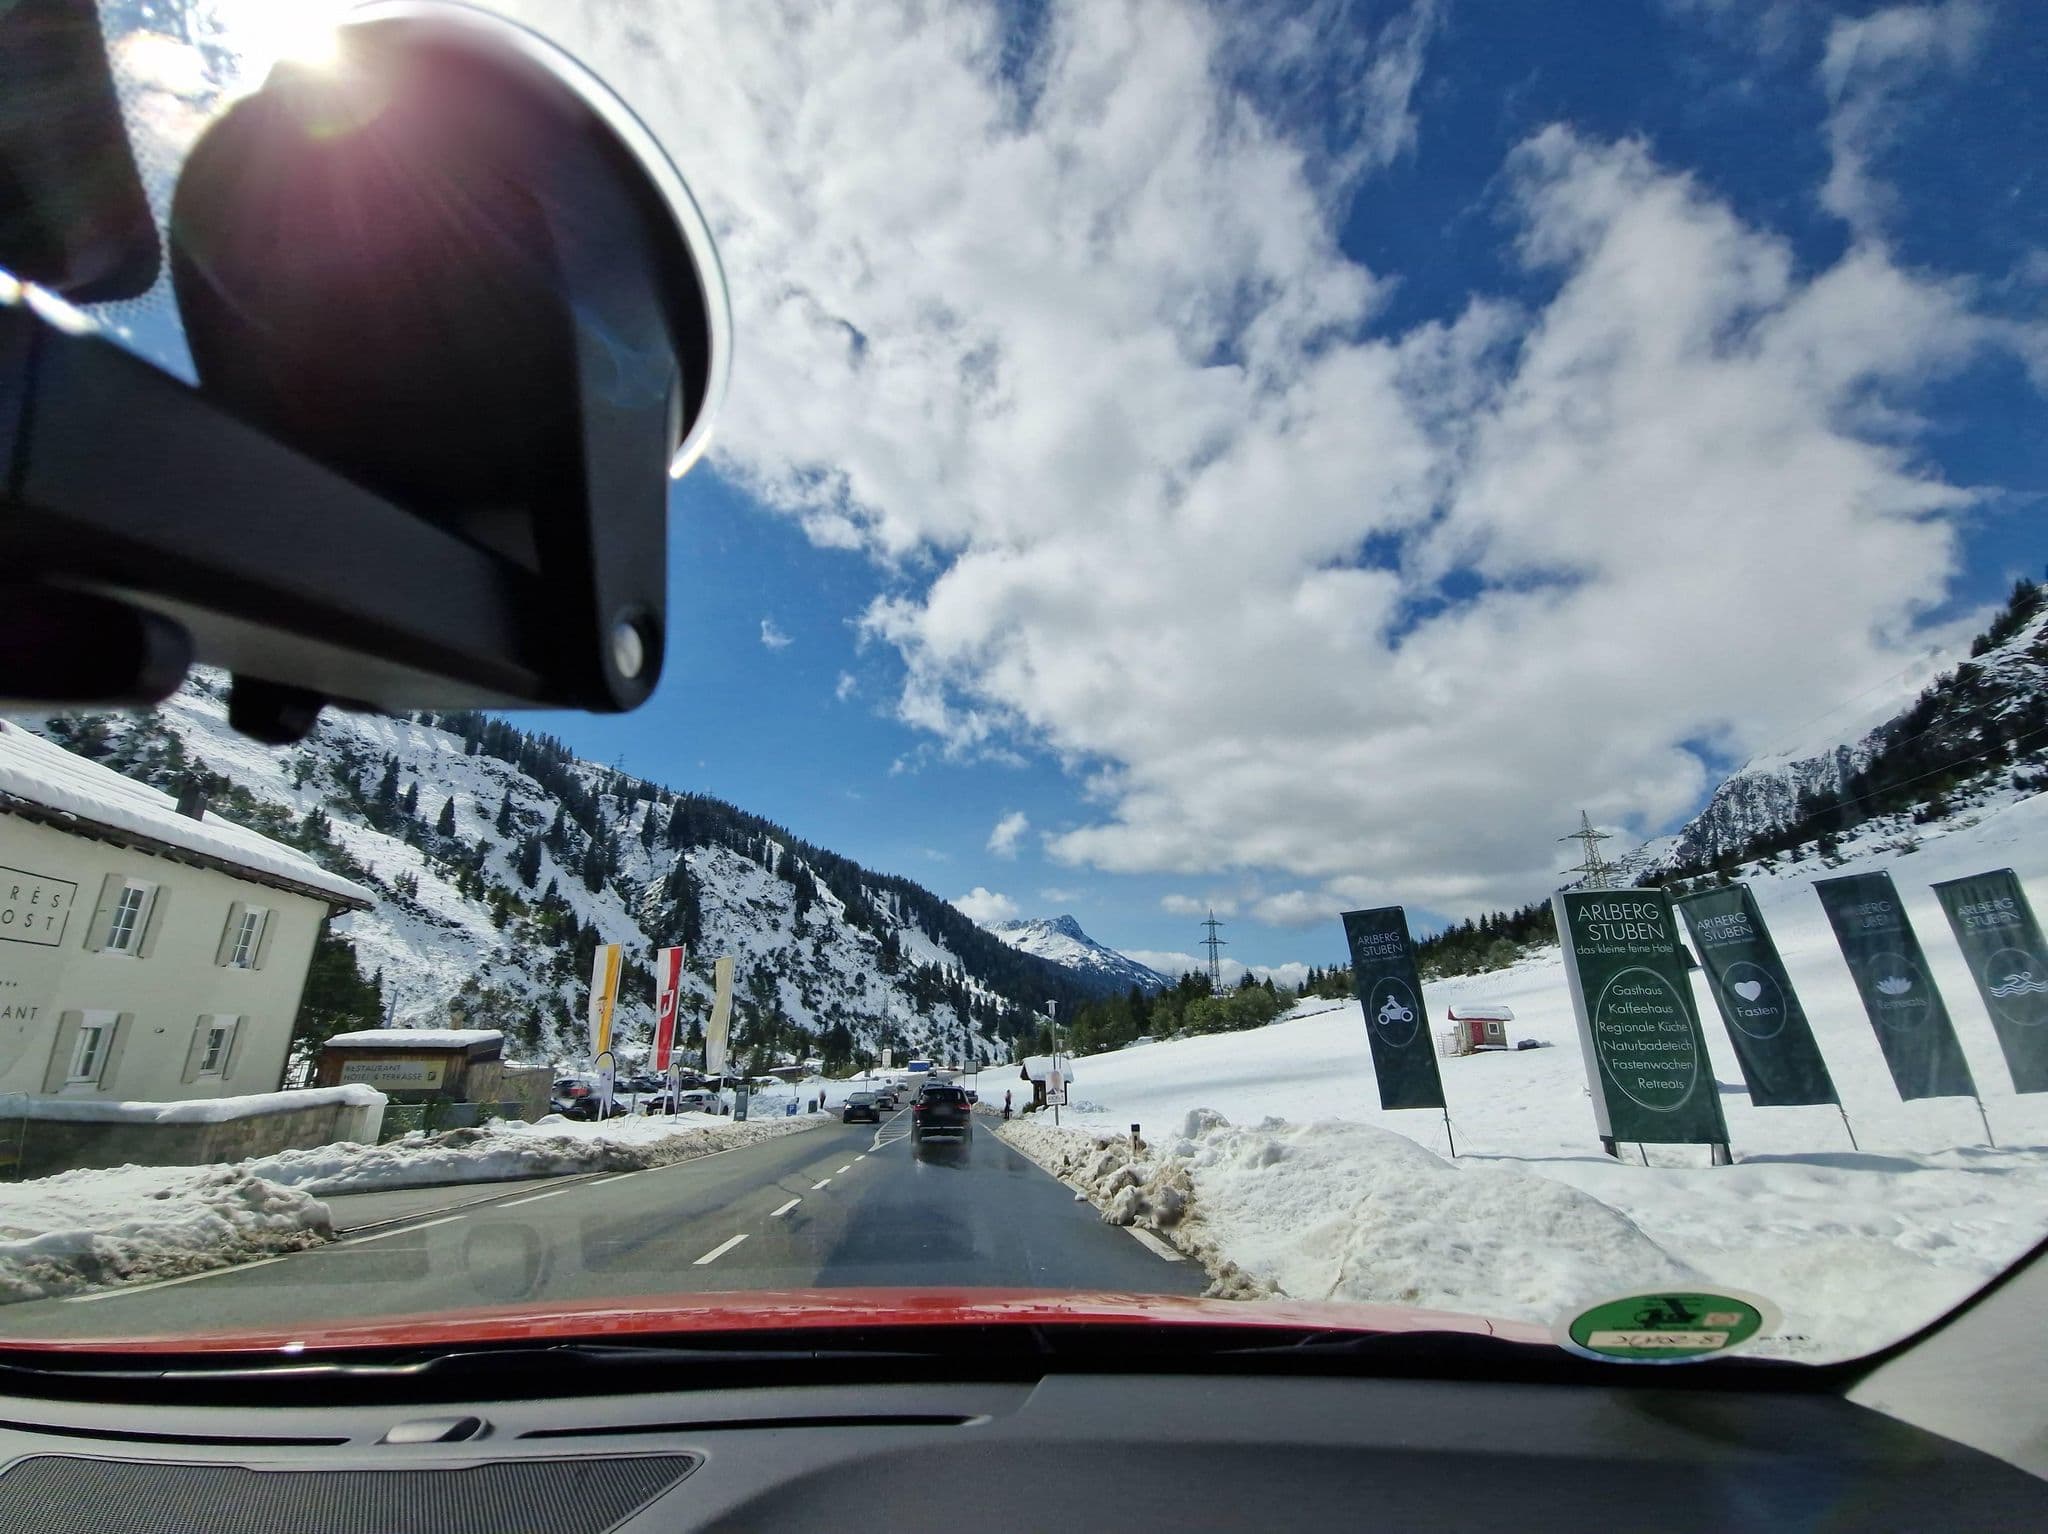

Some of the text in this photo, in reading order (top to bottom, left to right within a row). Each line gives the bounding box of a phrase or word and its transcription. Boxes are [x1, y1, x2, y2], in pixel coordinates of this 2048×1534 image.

[10, 885, 60, 908] RÈS
[1578, 903, 1659, 921] ARLBERG
[1957, 898, 2014, 917] ARLBERG
[1, 909, 54, 930] OST
[1697, 912, 1748, 931] ARLBERG
[1358, 931, 1400, 945] ARLBERG
[1588, 923, 1665, 940] STUBEN
[1704, 924, 1754, 942] STUBEN
[1363, 943, 1403, 957] STUBEN
[1577, 945, 1595, 954] das
[1598, 944, 1626, 953] kleine
[1653, 943, 1674, 952] Hotel
[1612, 985, 1663, 996] Gasthaus
[1, 1005, 38, 1020] ANT
[1609, 1002, 1674, 1014] Kaffeehaus
[1737, 1006, 1779, 1017] Fasten
[1600, 1021, 1688, 1035] Regionale Küche
[1603, 1040, 1693, 1051] Naturbadeteich
[1612, 1059, 1693, 1070] Fastenwochen
[1638, 1078, 1684, 1089] Retreats
